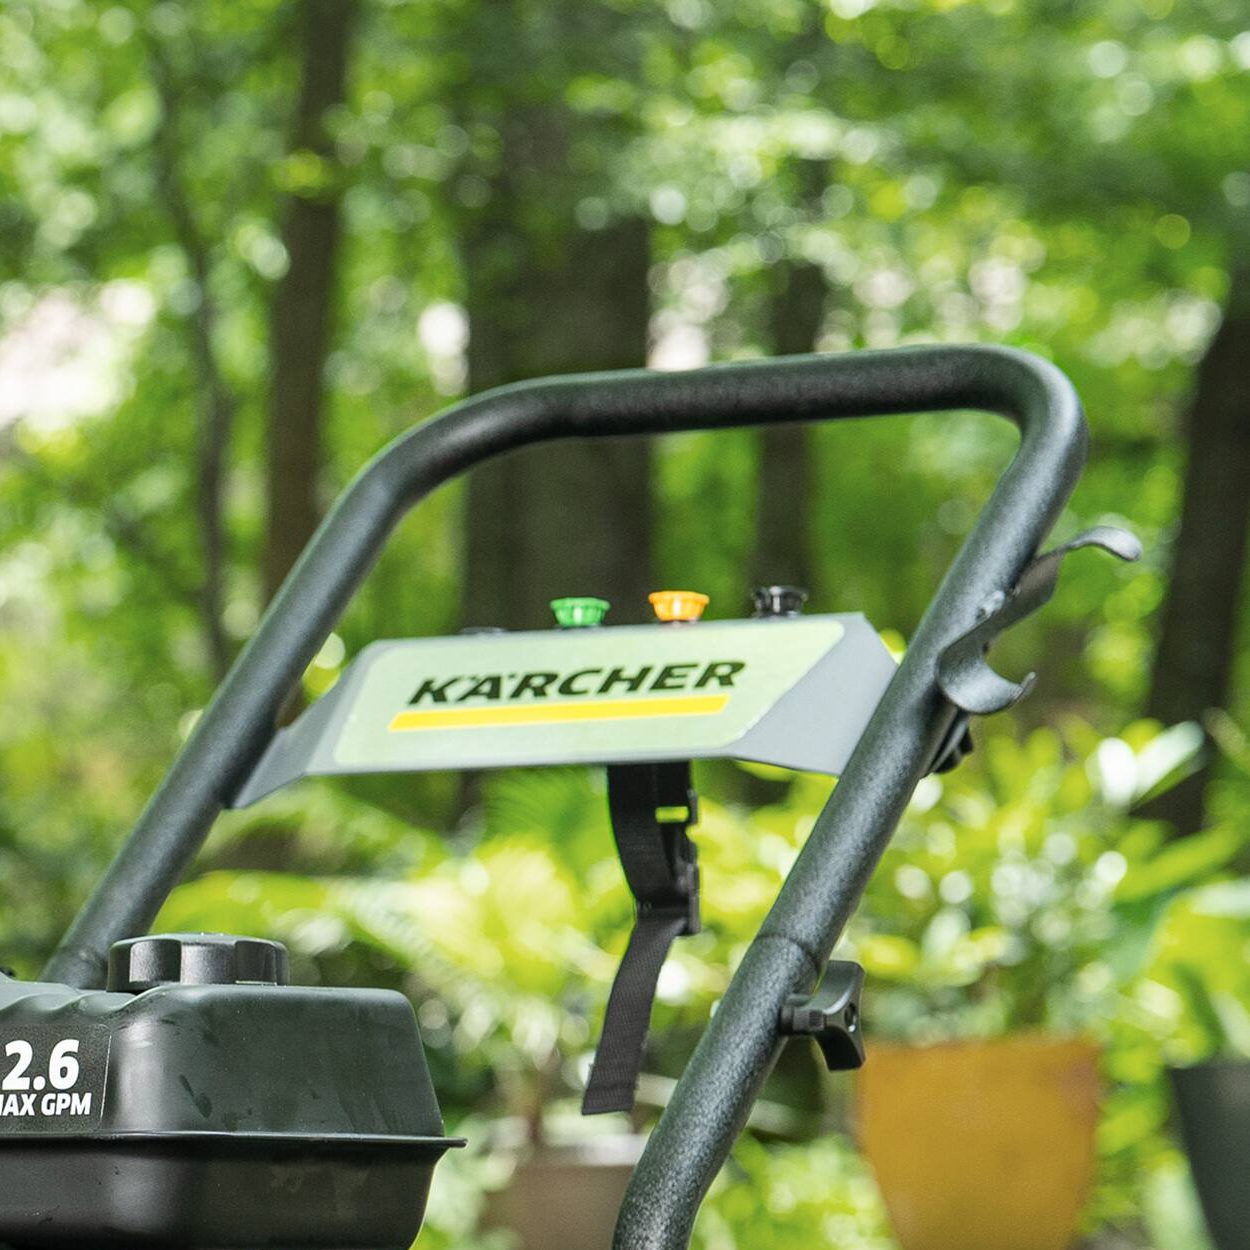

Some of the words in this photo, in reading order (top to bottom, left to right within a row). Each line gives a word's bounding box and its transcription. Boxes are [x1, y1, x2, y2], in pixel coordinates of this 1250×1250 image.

[407, 661, 746, 706] KÄRCHER
[1, 1039, 79, 1091] 2.6
[40, 1092, 92, 1116] GPM
